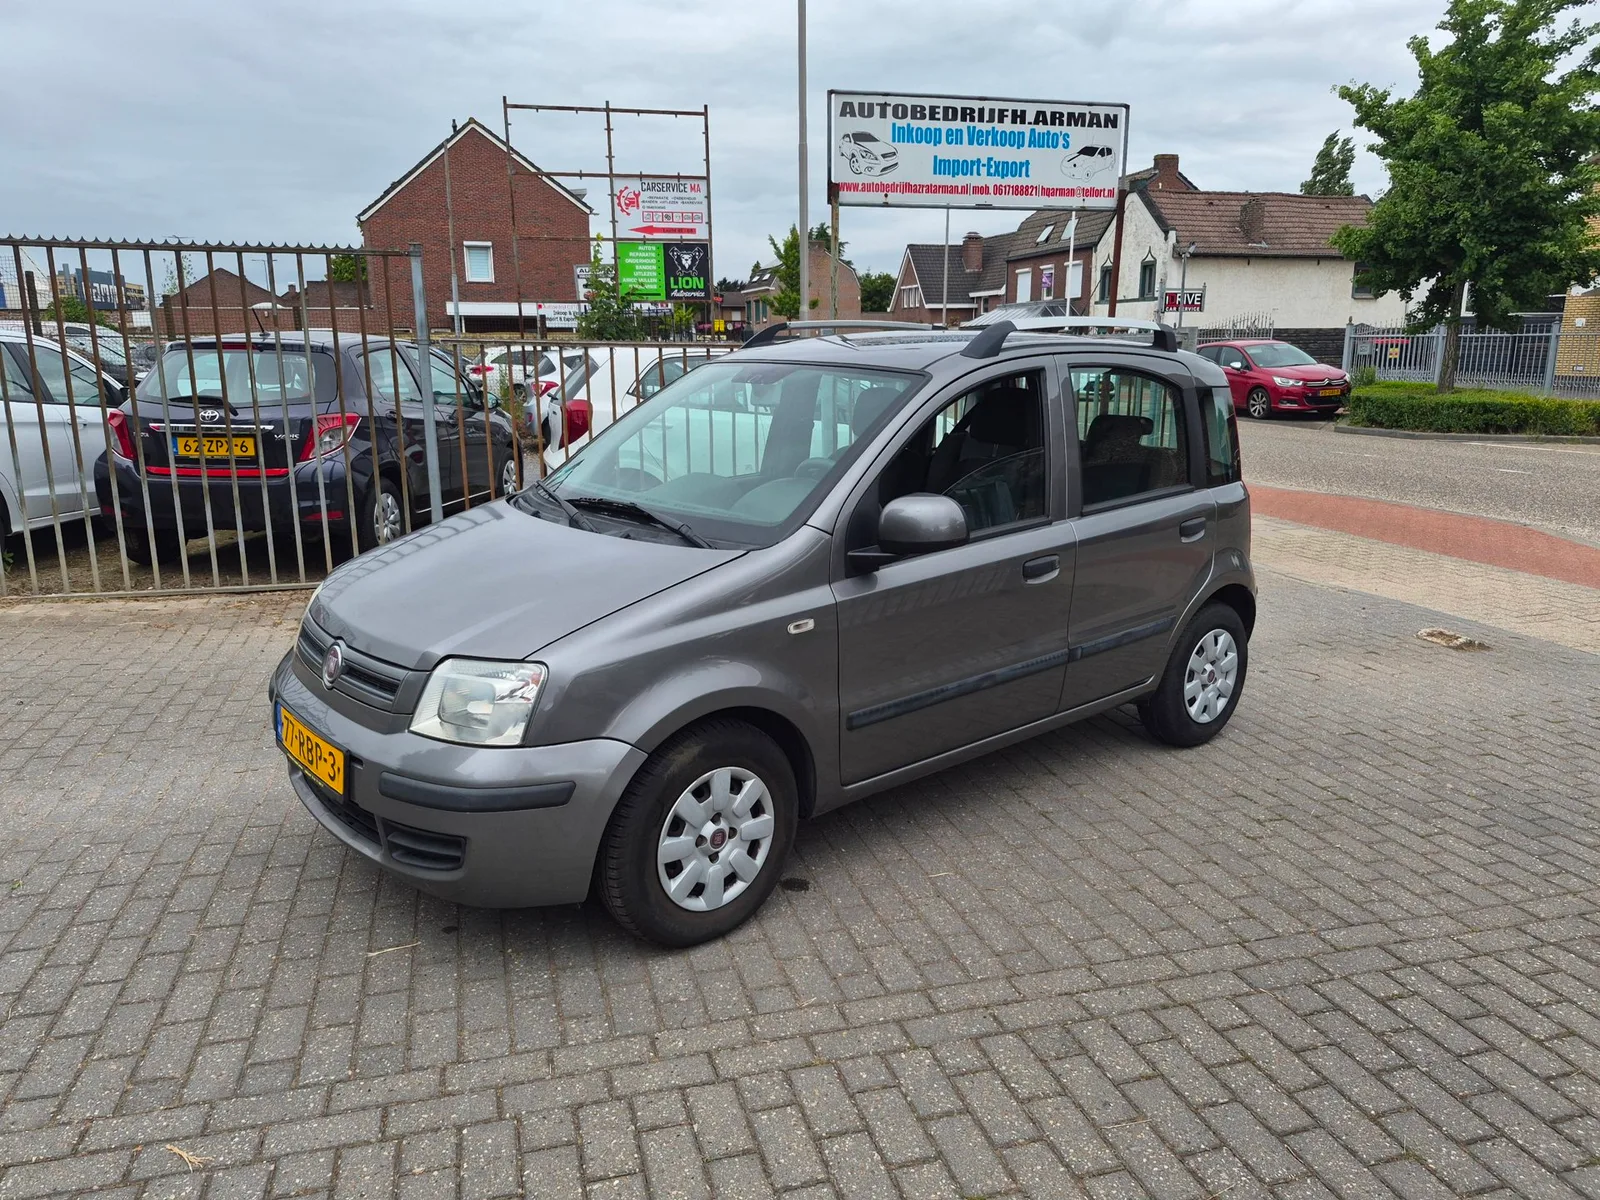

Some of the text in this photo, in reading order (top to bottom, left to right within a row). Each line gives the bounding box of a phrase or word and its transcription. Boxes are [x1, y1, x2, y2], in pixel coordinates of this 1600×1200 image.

[839, 101, 1119, 129] AUTOBEDRIJFH.ARMAN
[891, 122, 1070, 150] Inkoop en Verkoop Auto's
[933, 155, 1031, 179] Import-Export
[641, 181, 701, 193] CARSERVICE MA
[670, 277, 704, 289] LION
[671, 289, 705, 297] Autoservice
[284, 714, 336, 782] 77-RBP-3
